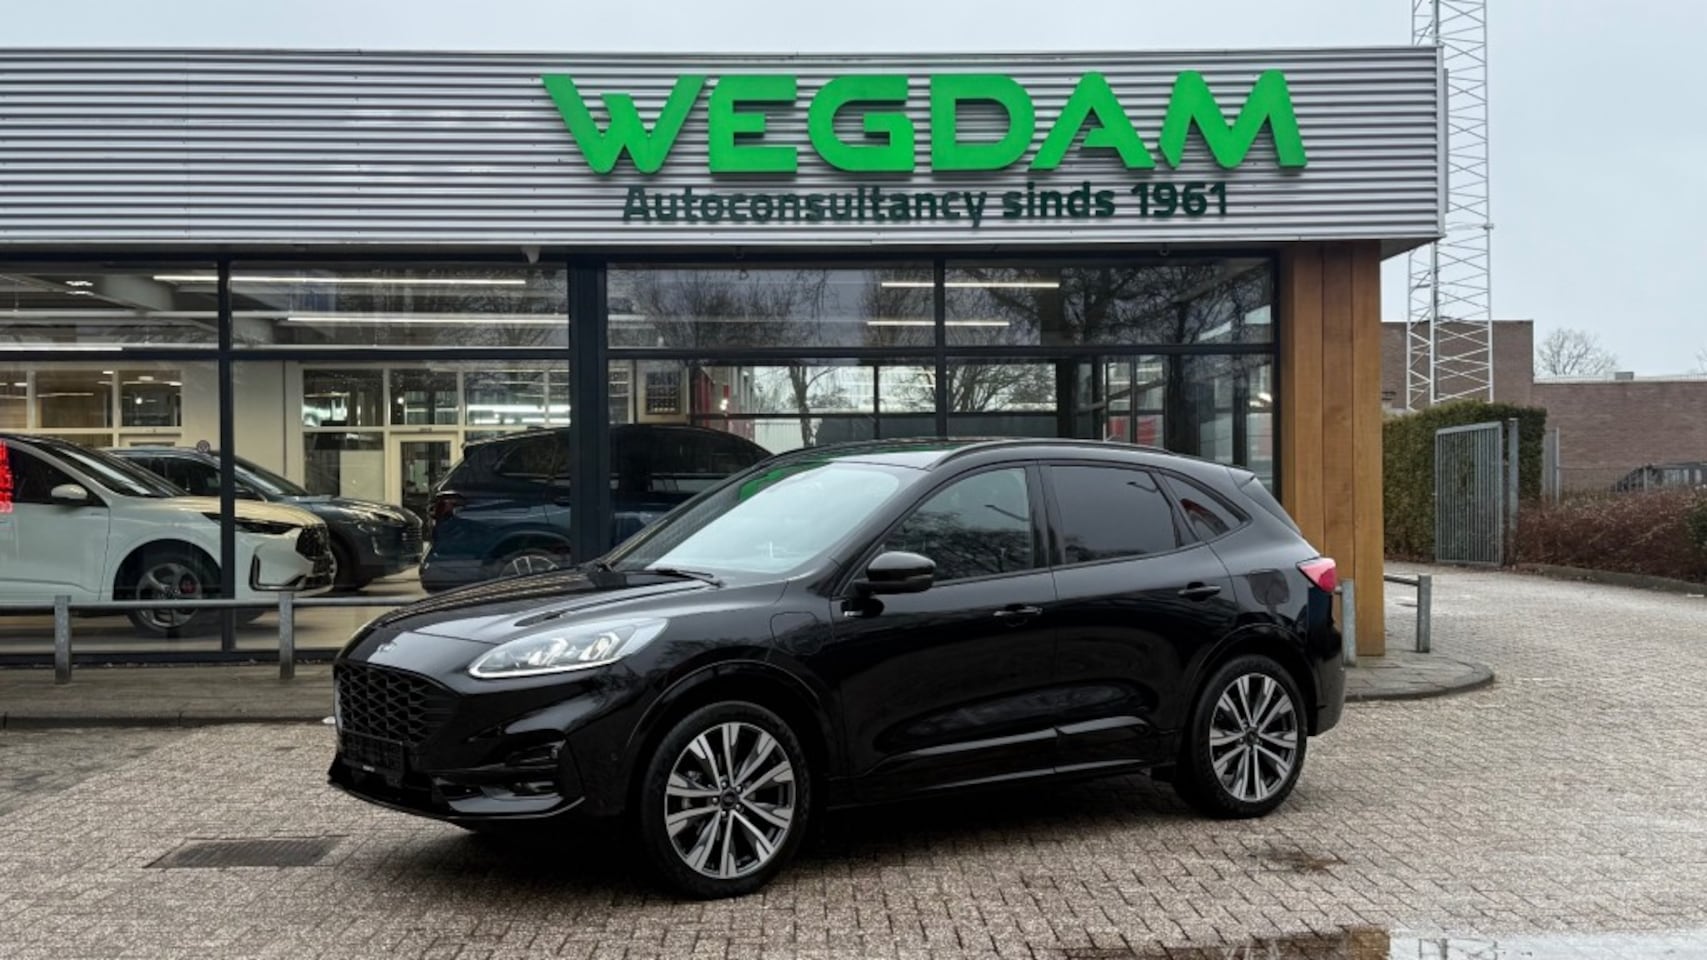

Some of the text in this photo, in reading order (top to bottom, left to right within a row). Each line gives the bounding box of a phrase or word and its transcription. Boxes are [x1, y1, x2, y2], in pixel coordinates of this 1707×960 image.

[541, 69, 1307, 175] WEGDAM
[622, 180, 1228, 229] Autoconsultancy sinds 1961
